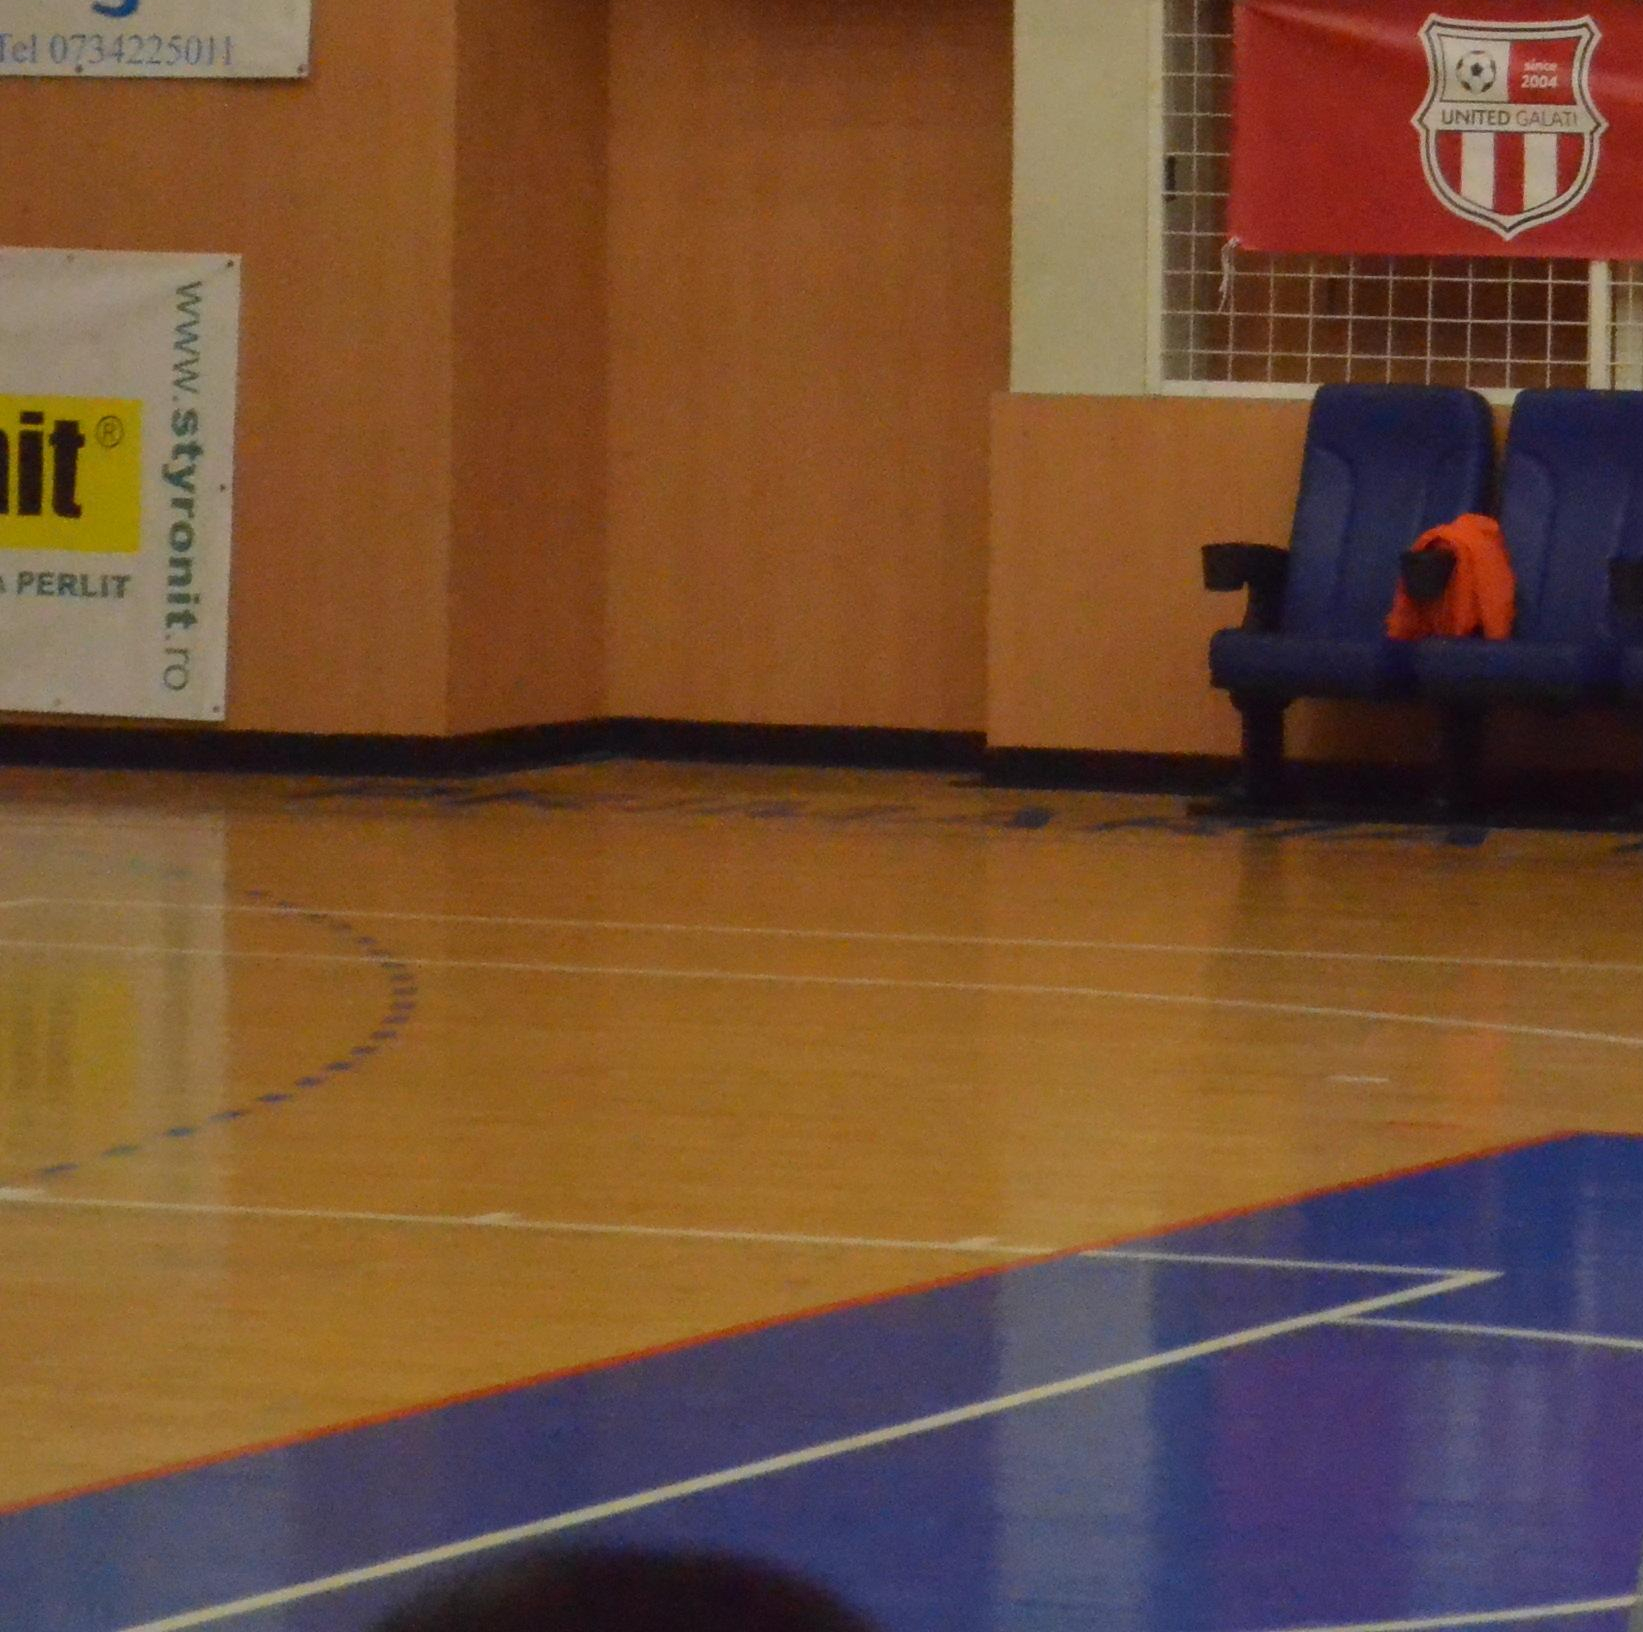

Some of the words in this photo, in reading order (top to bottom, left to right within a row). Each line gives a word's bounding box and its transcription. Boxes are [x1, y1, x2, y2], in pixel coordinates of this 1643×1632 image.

[50, 35, 234, 65] 0734225011
[1525, 59, 1557, 71] since
[1521, 75, 1557, 88] 2004
[1442, 109, 1510, 125] UNITED
[163, 281, 204, 691] www.styronit.ro
[18, 571, 130, 598] PERLIT
